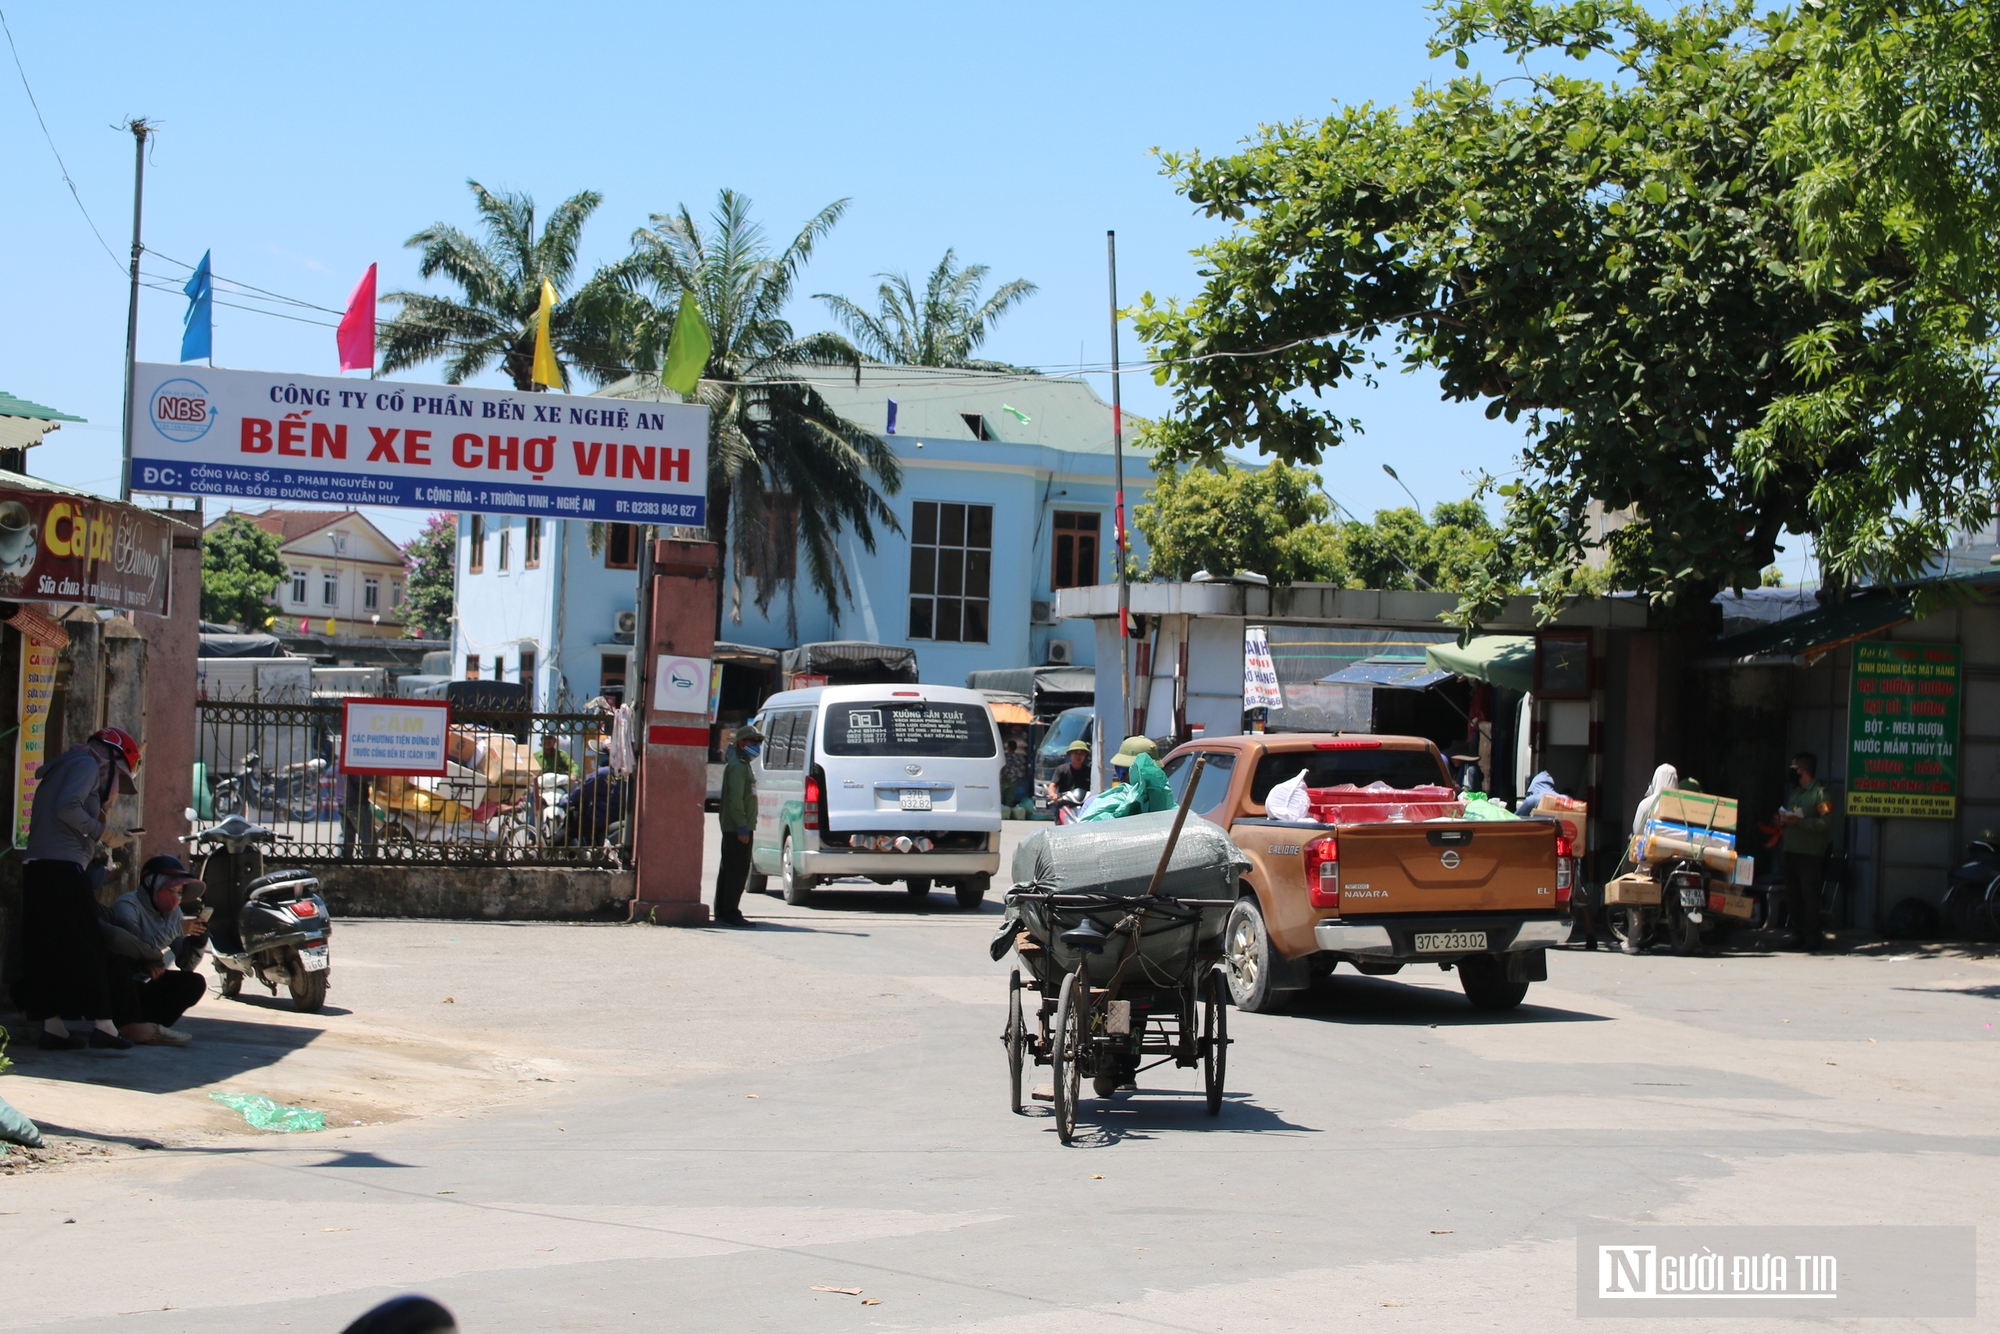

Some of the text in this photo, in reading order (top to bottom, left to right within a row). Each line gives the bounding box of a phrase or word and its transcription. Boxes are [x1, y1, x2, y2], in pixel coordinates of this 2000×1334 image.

[157, 396, 207, 422] NBS
[270, 383, 665, 431] CÔNG TY CỔ PHẦN BẾN XE NGHỆ AN
[240, 409, 691, 483] BẾN XE CHỢ VINH
[143, 467, 183, 486] ĐC:
[190, 465, 223, 479] CỔNG
[225, 467, 251, 481] VÀO:
[254, 469, 270, 482] SỐ
[284, 474, 295, 485] Đ.
[298, 475, 328, 488] PHẠM
[331, 475, 376, 490] NGUYỄN
[378, 480, 394, 491] DU
[190, 480, 400, 505] CỔNG RA: SỐ 9B ĐƯỜNG CAO XUÂN HUY
[415, 488, 425, 501] K.
[427, 487, 452, 505] CỘNG
[454, 487, 472, 504] HÒA
[480, 491, 489, 505] P.
[490, 490, 526, 508] TRƯỜNG
[528, 494, 549, 509] VINH
[556, 495, 580, 513] NGHỆ
[582, 498, 595, 512] AN
[616, 501, 697, 518] ĐT: 02383 842 627
[58, 576, 80, 596] chua
[1858, 662, 1955, 678] KINH DOANH CÁC MẶT HÀNG
[1858, 678, 1878, 696] HẠT
[1863, 698, 1884, 716] HẠT
[370, 710, 424, 733] CẤM
[1864, 718, 1884, 736] BỘT
[1892, 722, 1915, 735] MEN
[1918, 722, 1944, 739] RƯỢU
[352, 734, 366, 743] CÁC
[396, 736, 410, 746] TIỆN
[1854, 738, 1881, 753] NƯỚC
[1912, 738, 1936, 756] THỦY
[1938, 742, 1953, 757] TÀI
[399, 750, 406, 759] XE
[1854, 776, 1888, 791] HÀNG
[1890, 777, 1925, 793] NÔNG
[906, 790, 923, 799] 37D
[902, 800, 930, 809] 032.82
[1268, 844, 1300, 856] CALIBRE
[1345, 890, 1389, 899] NAVARA
[1416, 933, 1486, 951] 37C-233.02
